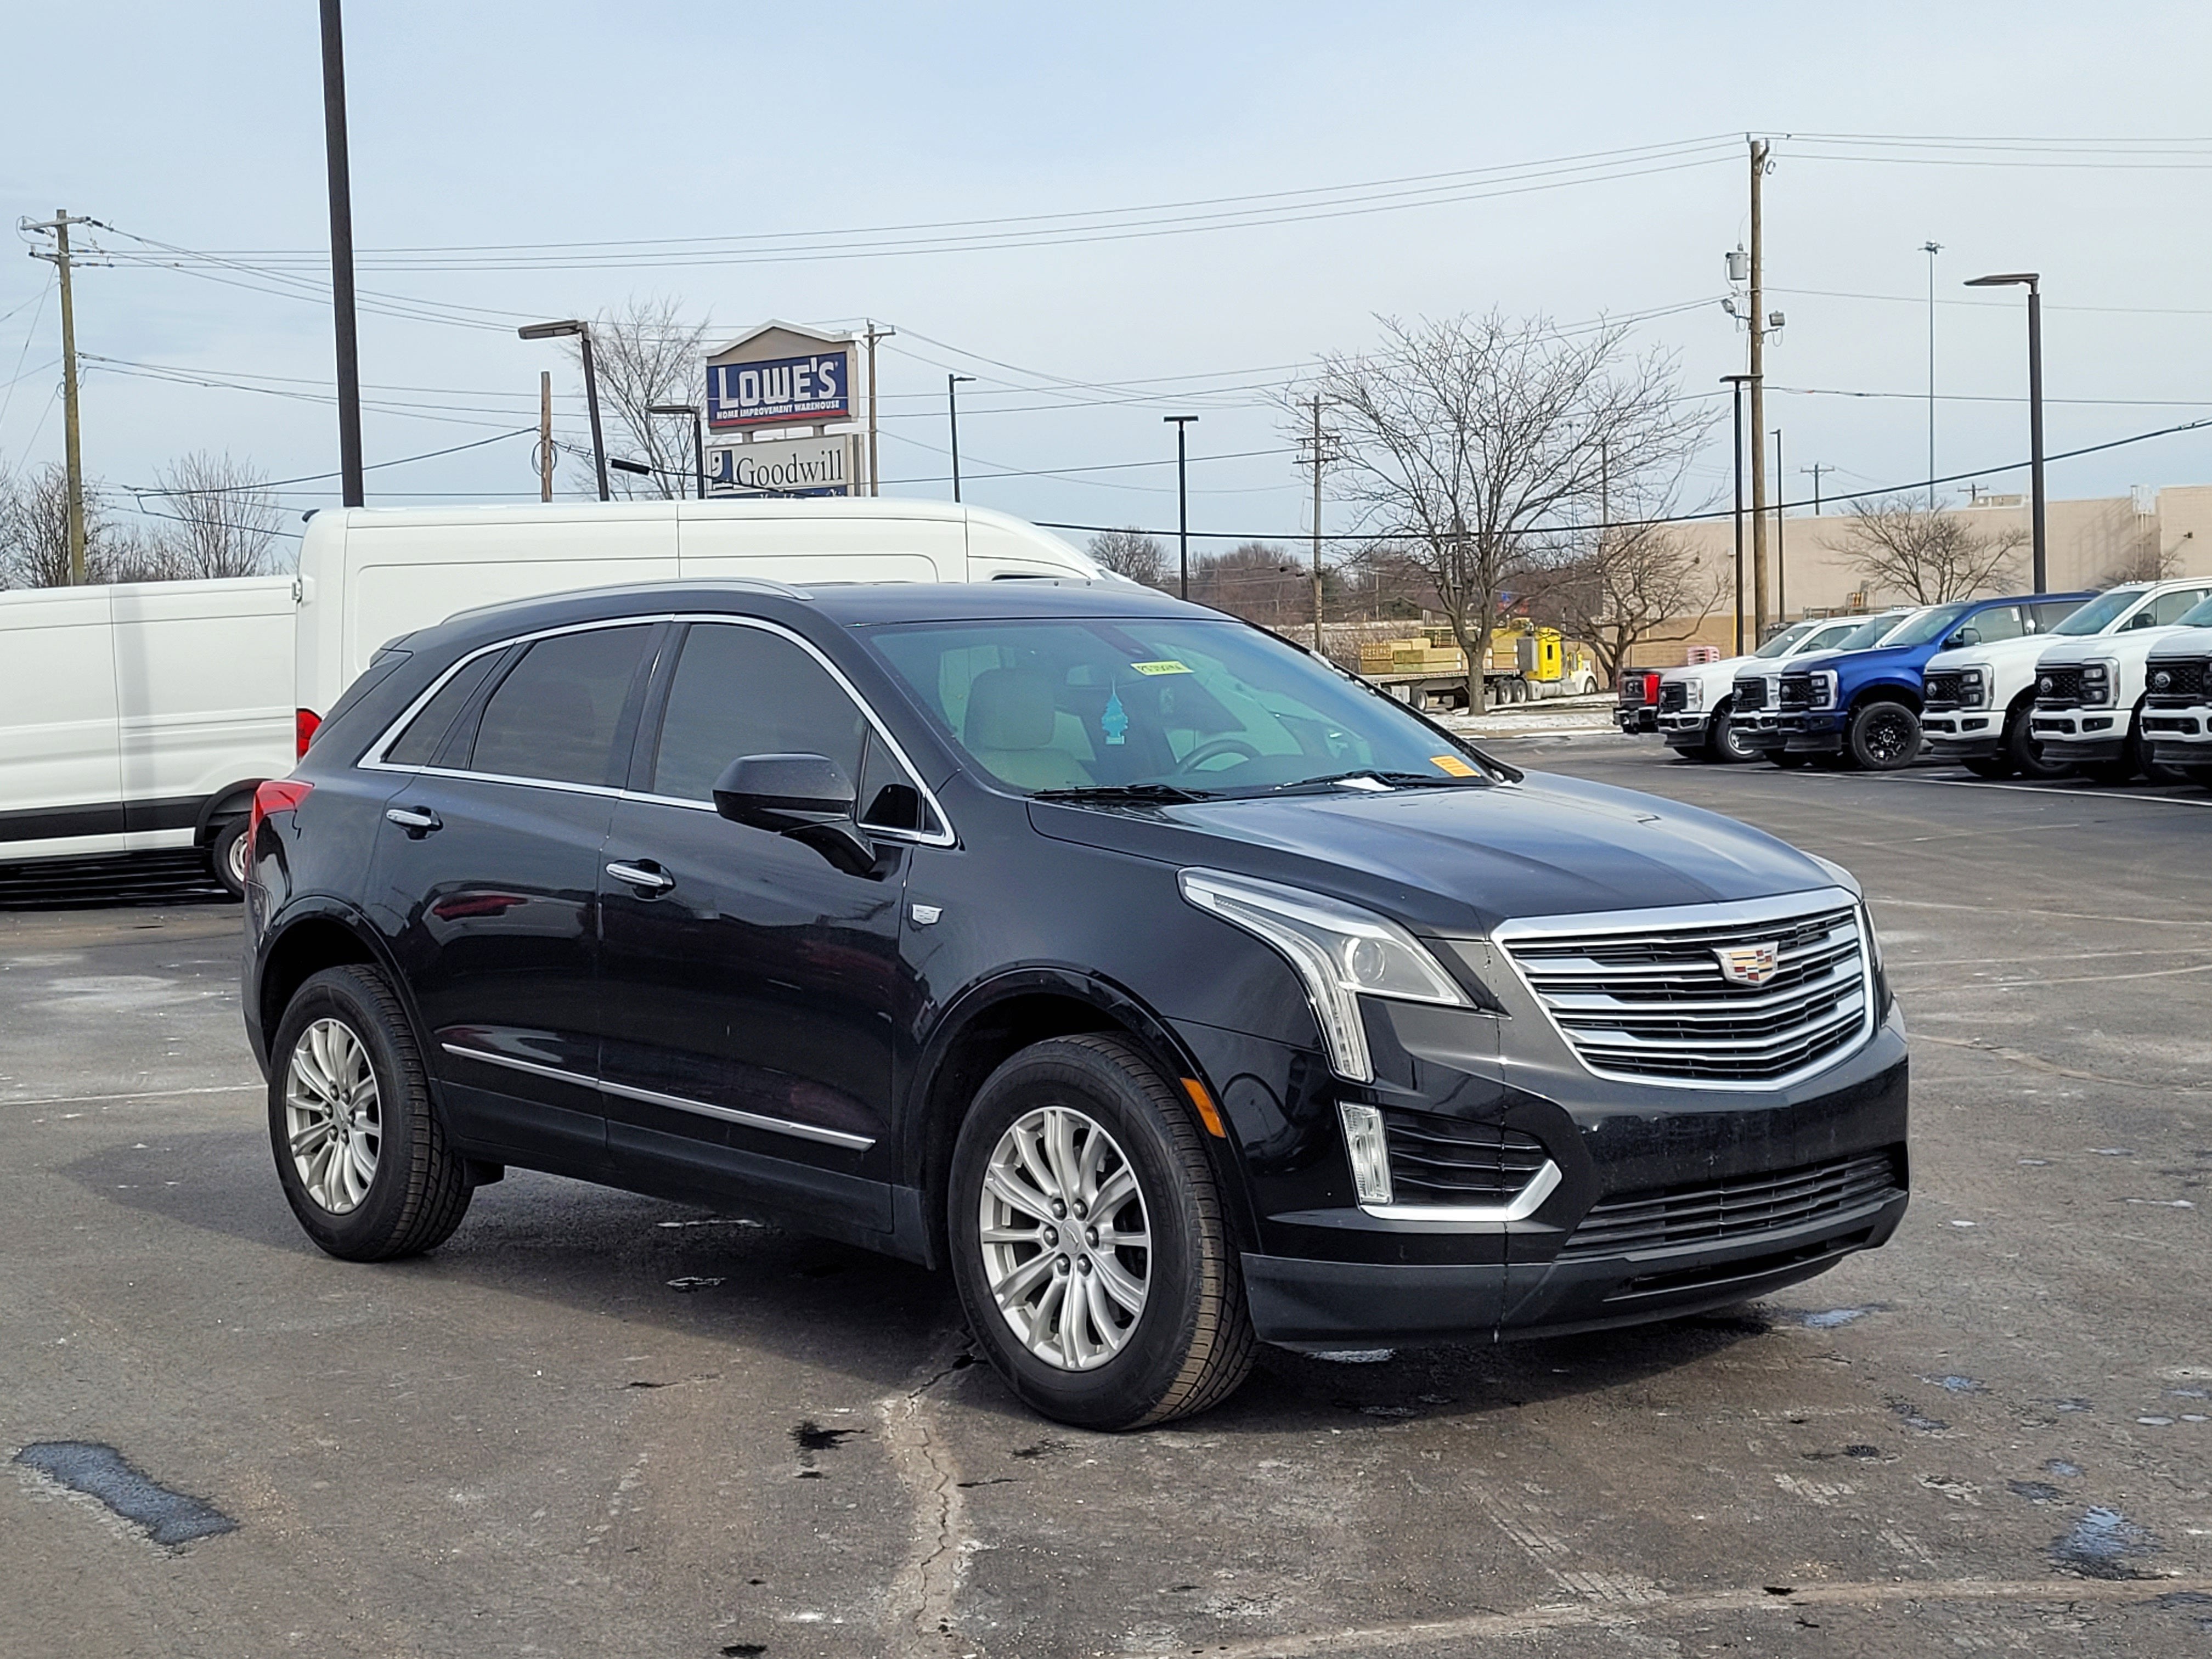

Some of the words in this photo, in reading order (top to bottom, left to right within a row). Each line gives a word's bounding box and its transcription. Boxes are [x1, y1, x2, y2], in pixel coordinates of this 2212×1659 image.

[718, 357, 837, 409] LOWE'S
[716, 411, 738, 420] HOME
[740, 404, 792, 417] IMPROVEMENT
[794, 400, 840, 410] WAREHOUSE
[736, 449, 843, 486] Goodwill
